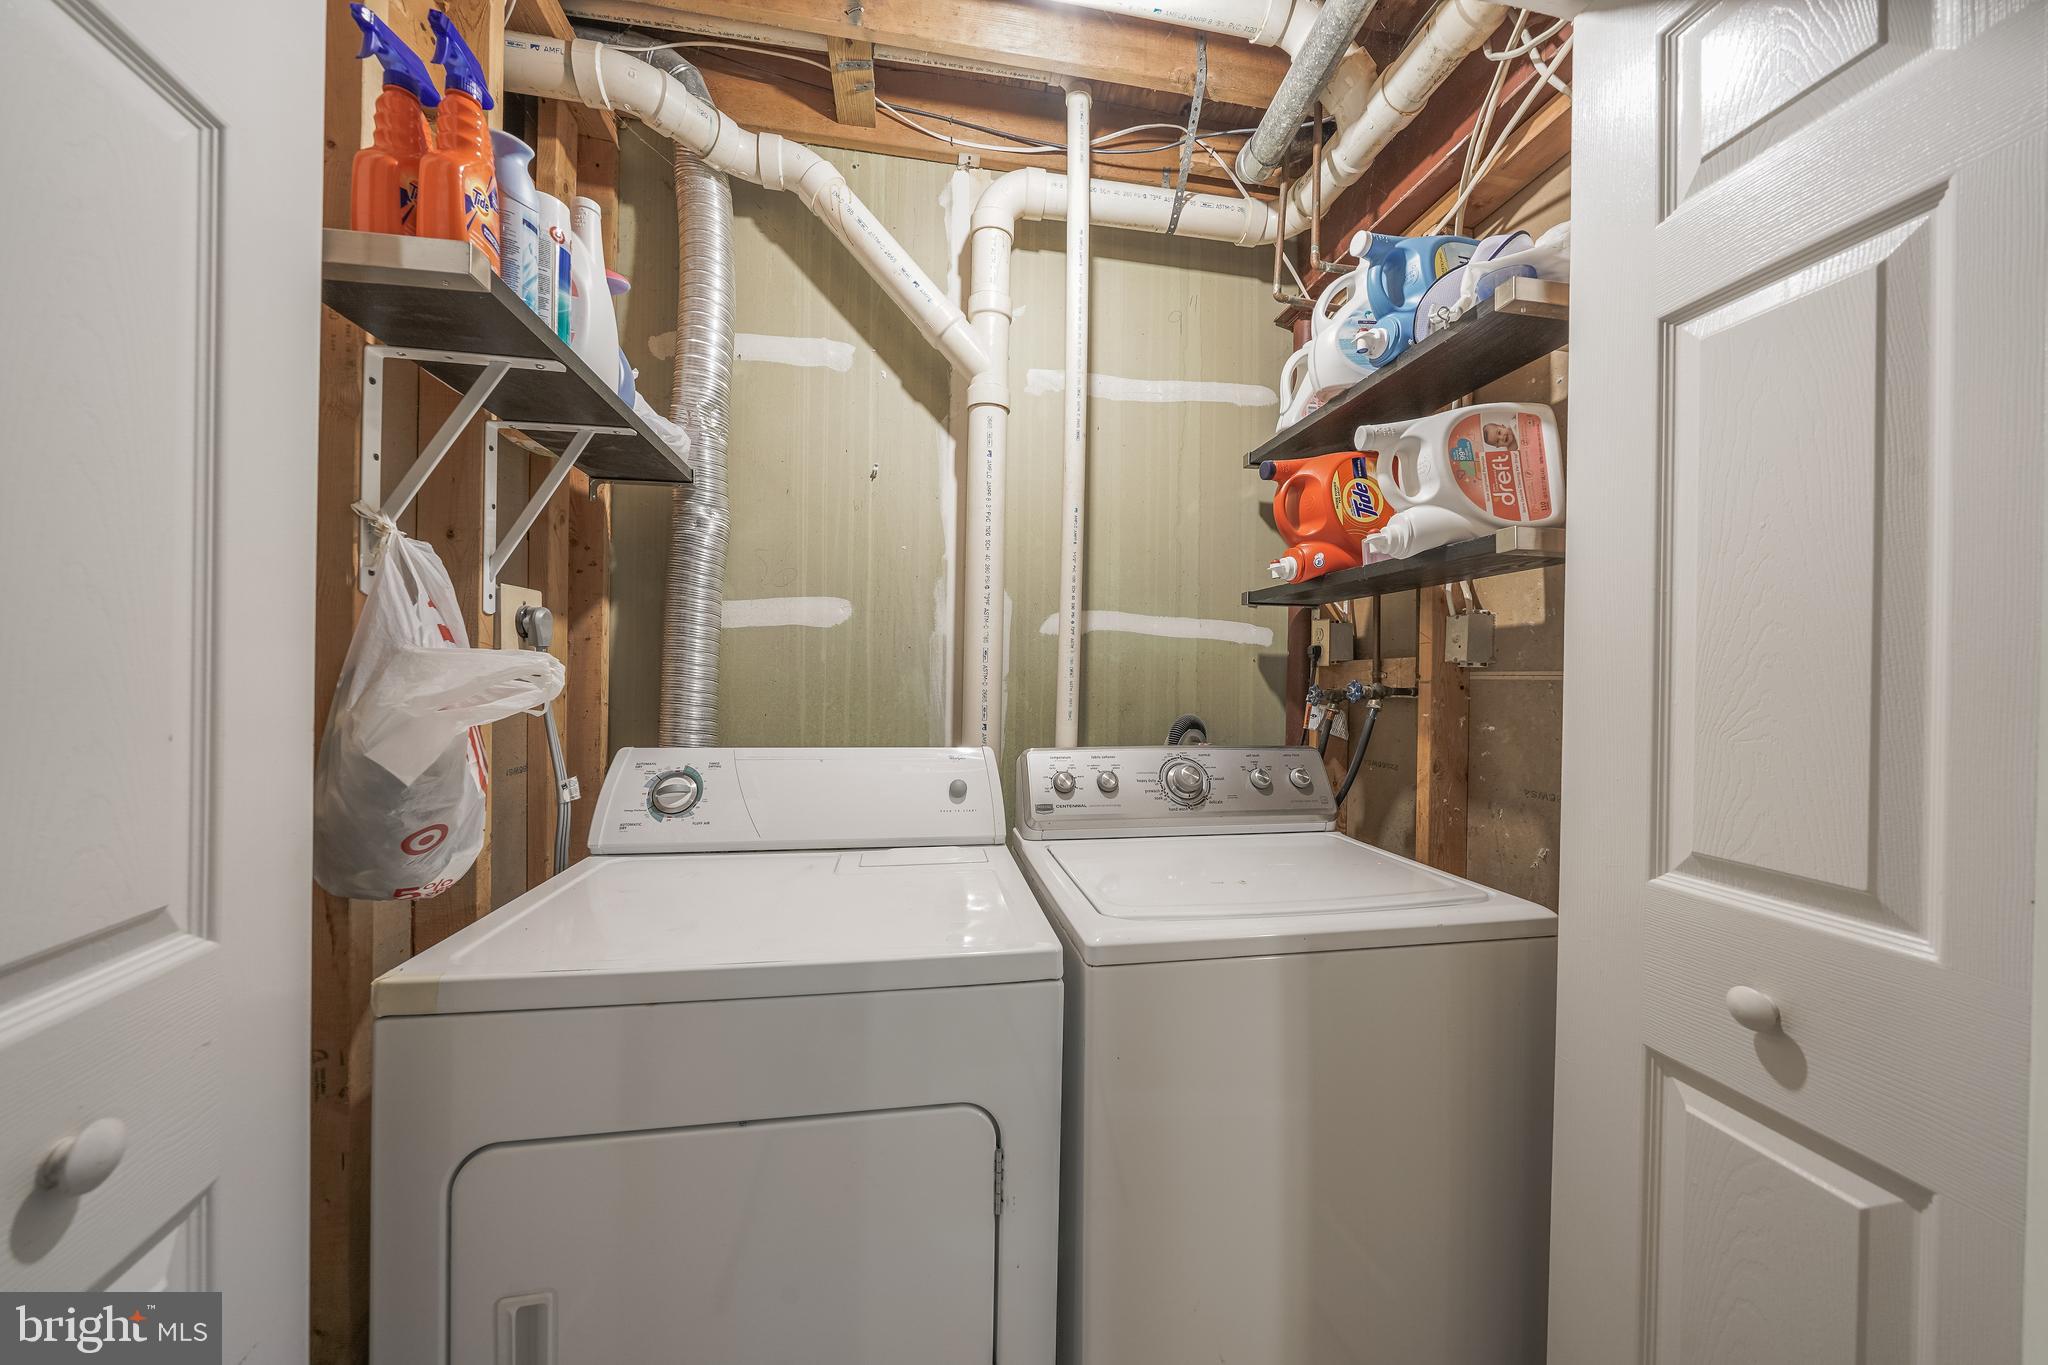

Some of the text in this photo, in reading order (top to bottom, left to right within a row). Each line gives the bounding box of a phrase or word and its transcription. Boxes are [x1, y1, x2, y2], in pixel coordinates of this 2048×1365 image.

[472, 188, 489, 213] Tide
[1492, 453, 1516, 506] dreft
[1352, 482, 1379, 518] Tide
